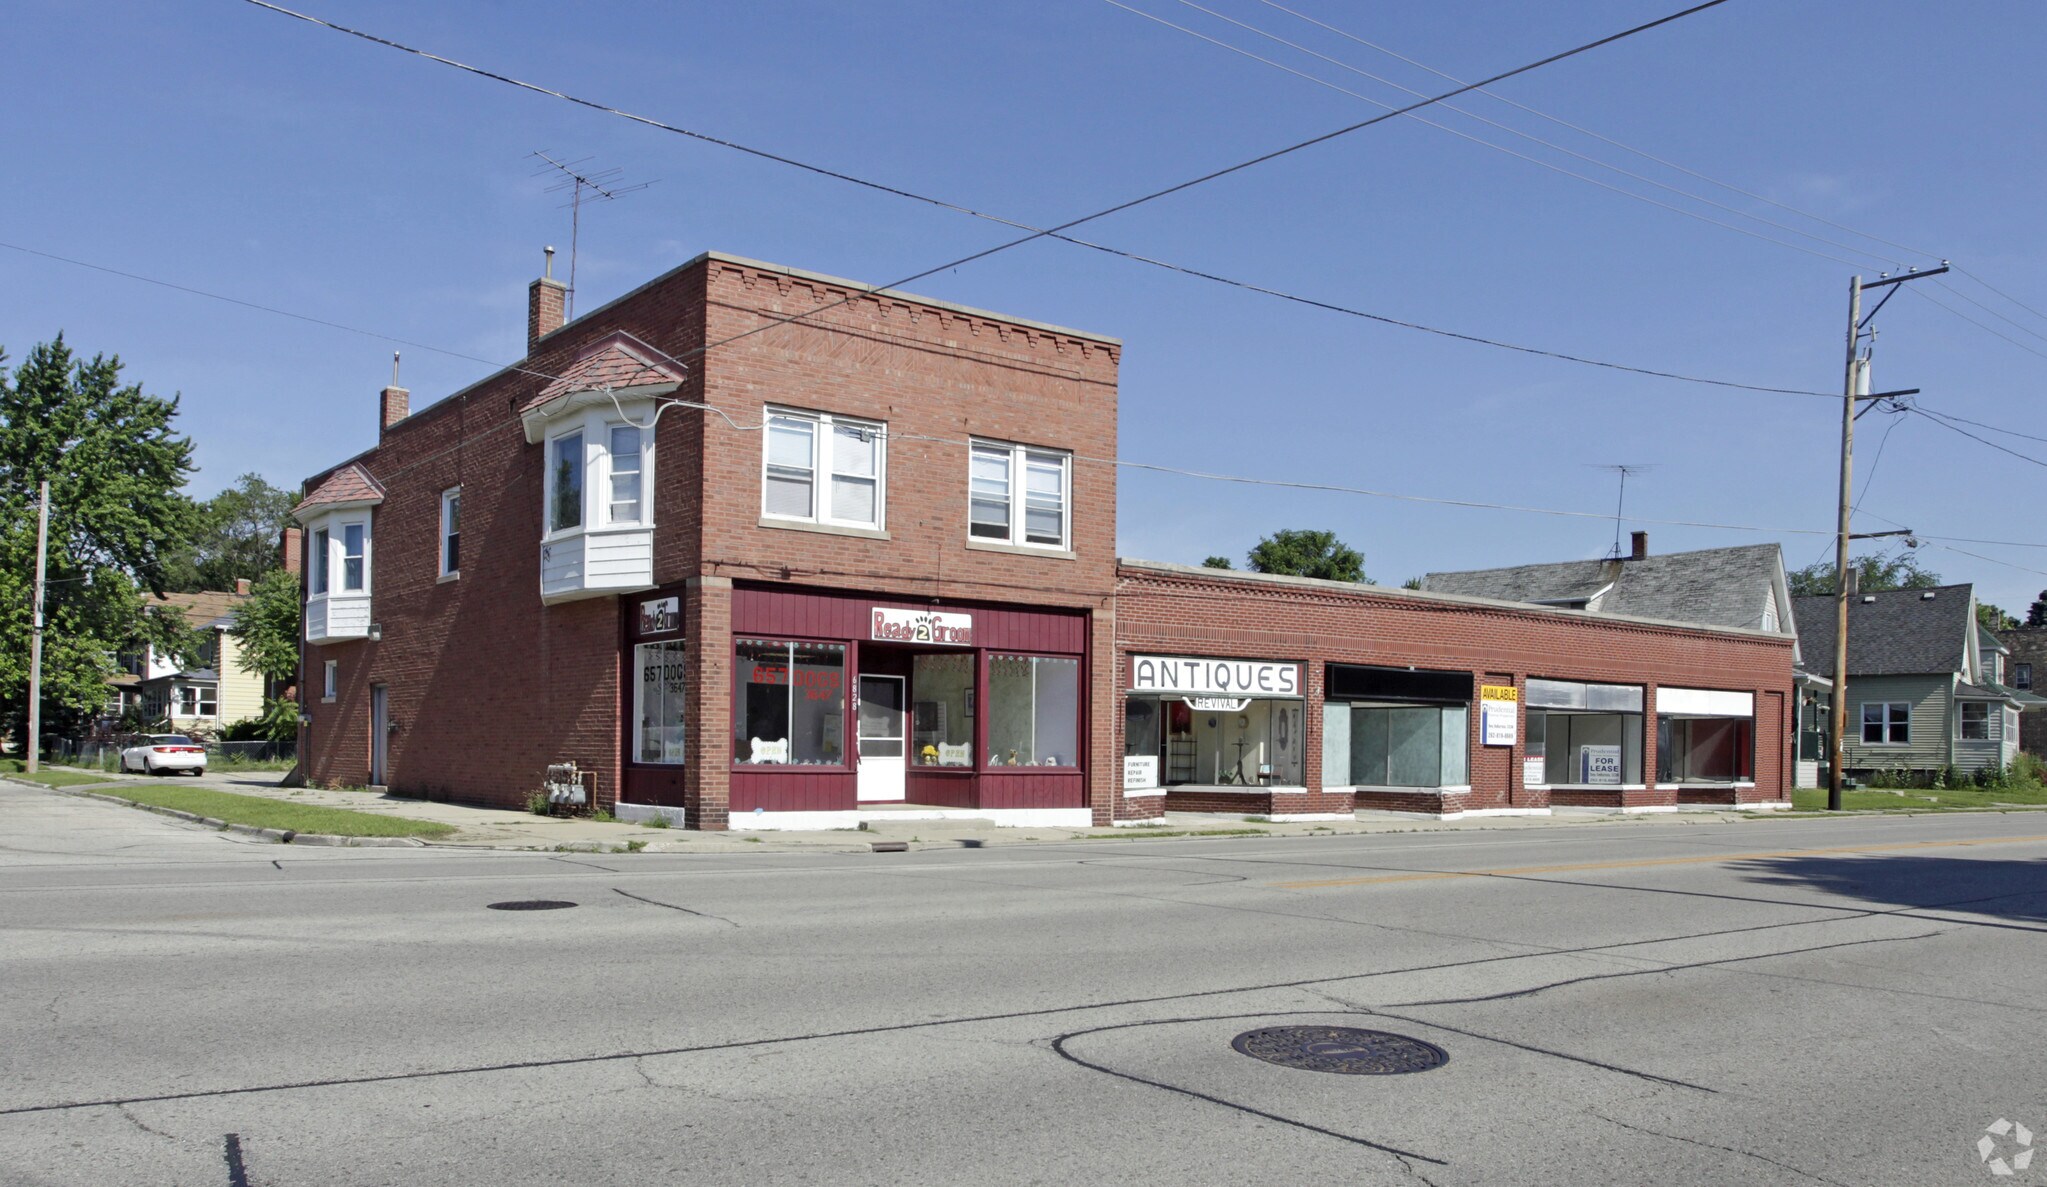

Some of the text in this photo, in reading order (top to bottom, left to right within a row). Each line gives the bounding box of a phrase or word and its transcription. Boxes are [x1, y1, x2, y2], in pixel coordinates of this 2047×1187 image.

[874, 611, 916, 641] Ready
[918, 626, 928, 640] 2
[644, 666, 662, 682] 657
[753, 666, 840, 689] 657 DOGS
[1137, 659, 1295, 693] ANTIQUES
[669, 682, 686, 693] 3647
[1482, 688, 1516, 701] AVAILABLE
[1197, 698, 1237, 709] REVIVAL
[1595, 757, 1614, 765] FOR
[1590, 765, 1620, 773] LEASE
